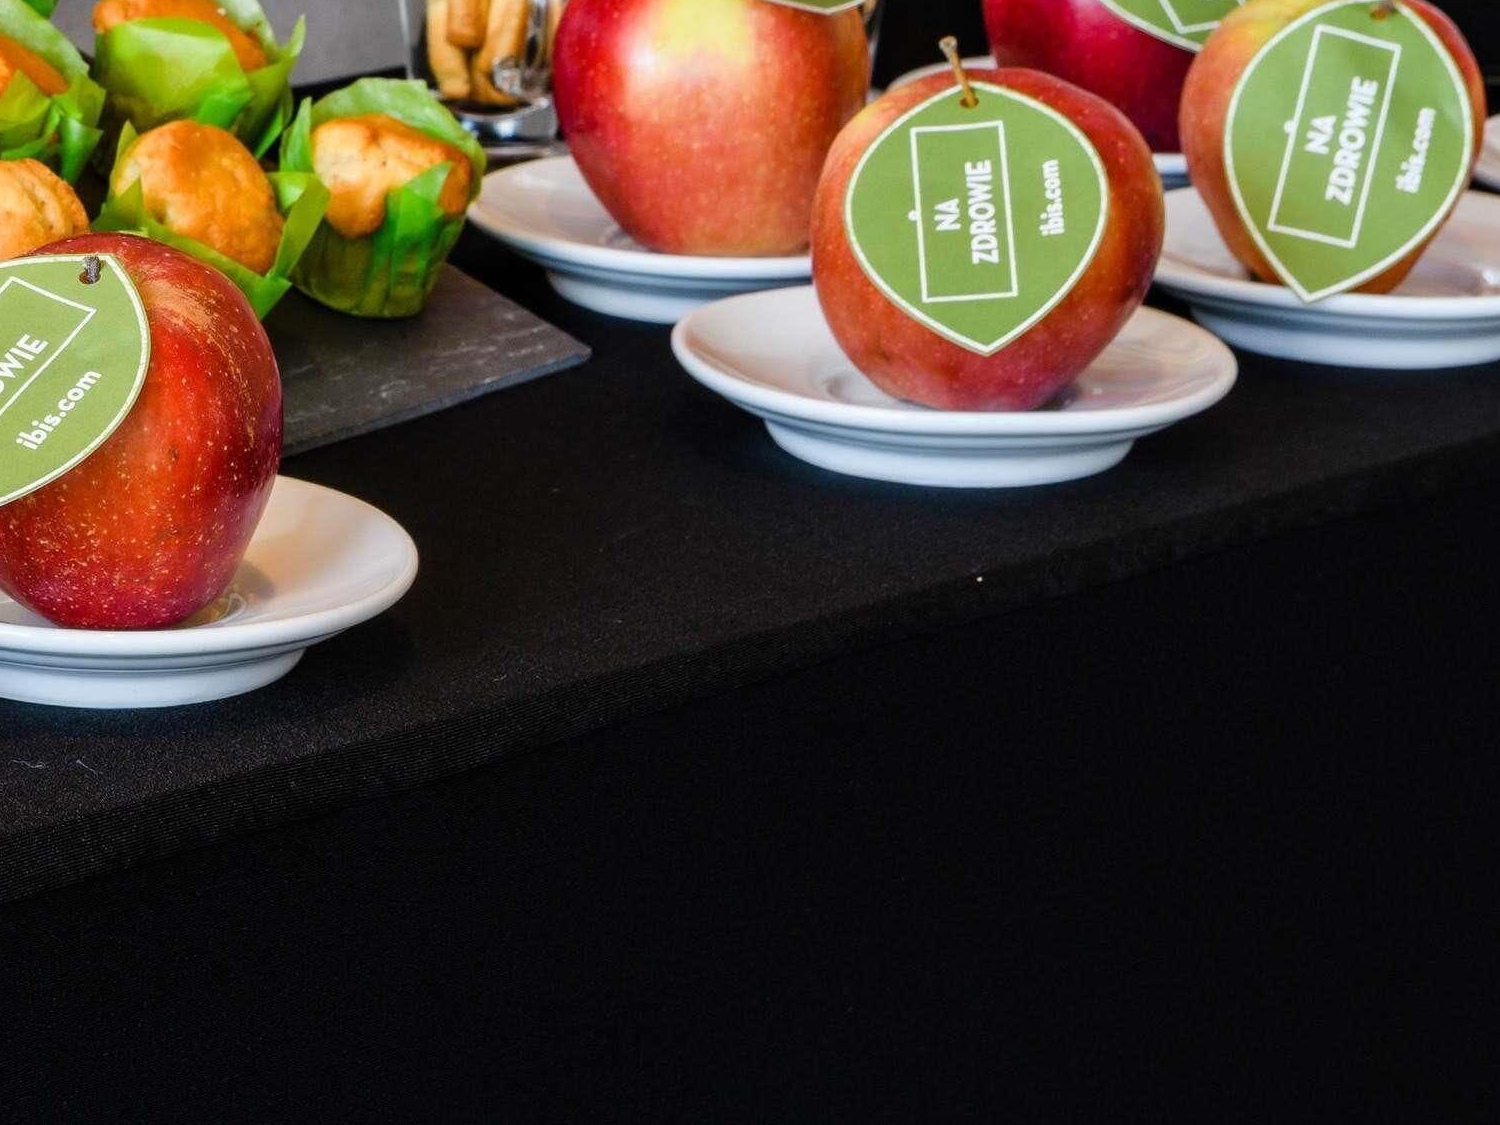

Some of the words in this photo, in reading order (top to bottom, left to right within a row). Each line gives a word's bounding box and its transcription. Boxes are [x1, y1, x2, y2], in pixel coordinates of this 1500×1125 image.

[1303, 114, 1337, 155] NA
[1324, 75, 1379, 206] ZDROWIE
[934, 197, 961, 231] NA
[964, 158, 999, 264] ZDROWIE
[1039, 159, 1065, 236] ibis.com
[16, 370, 102, 449] ibis.com
